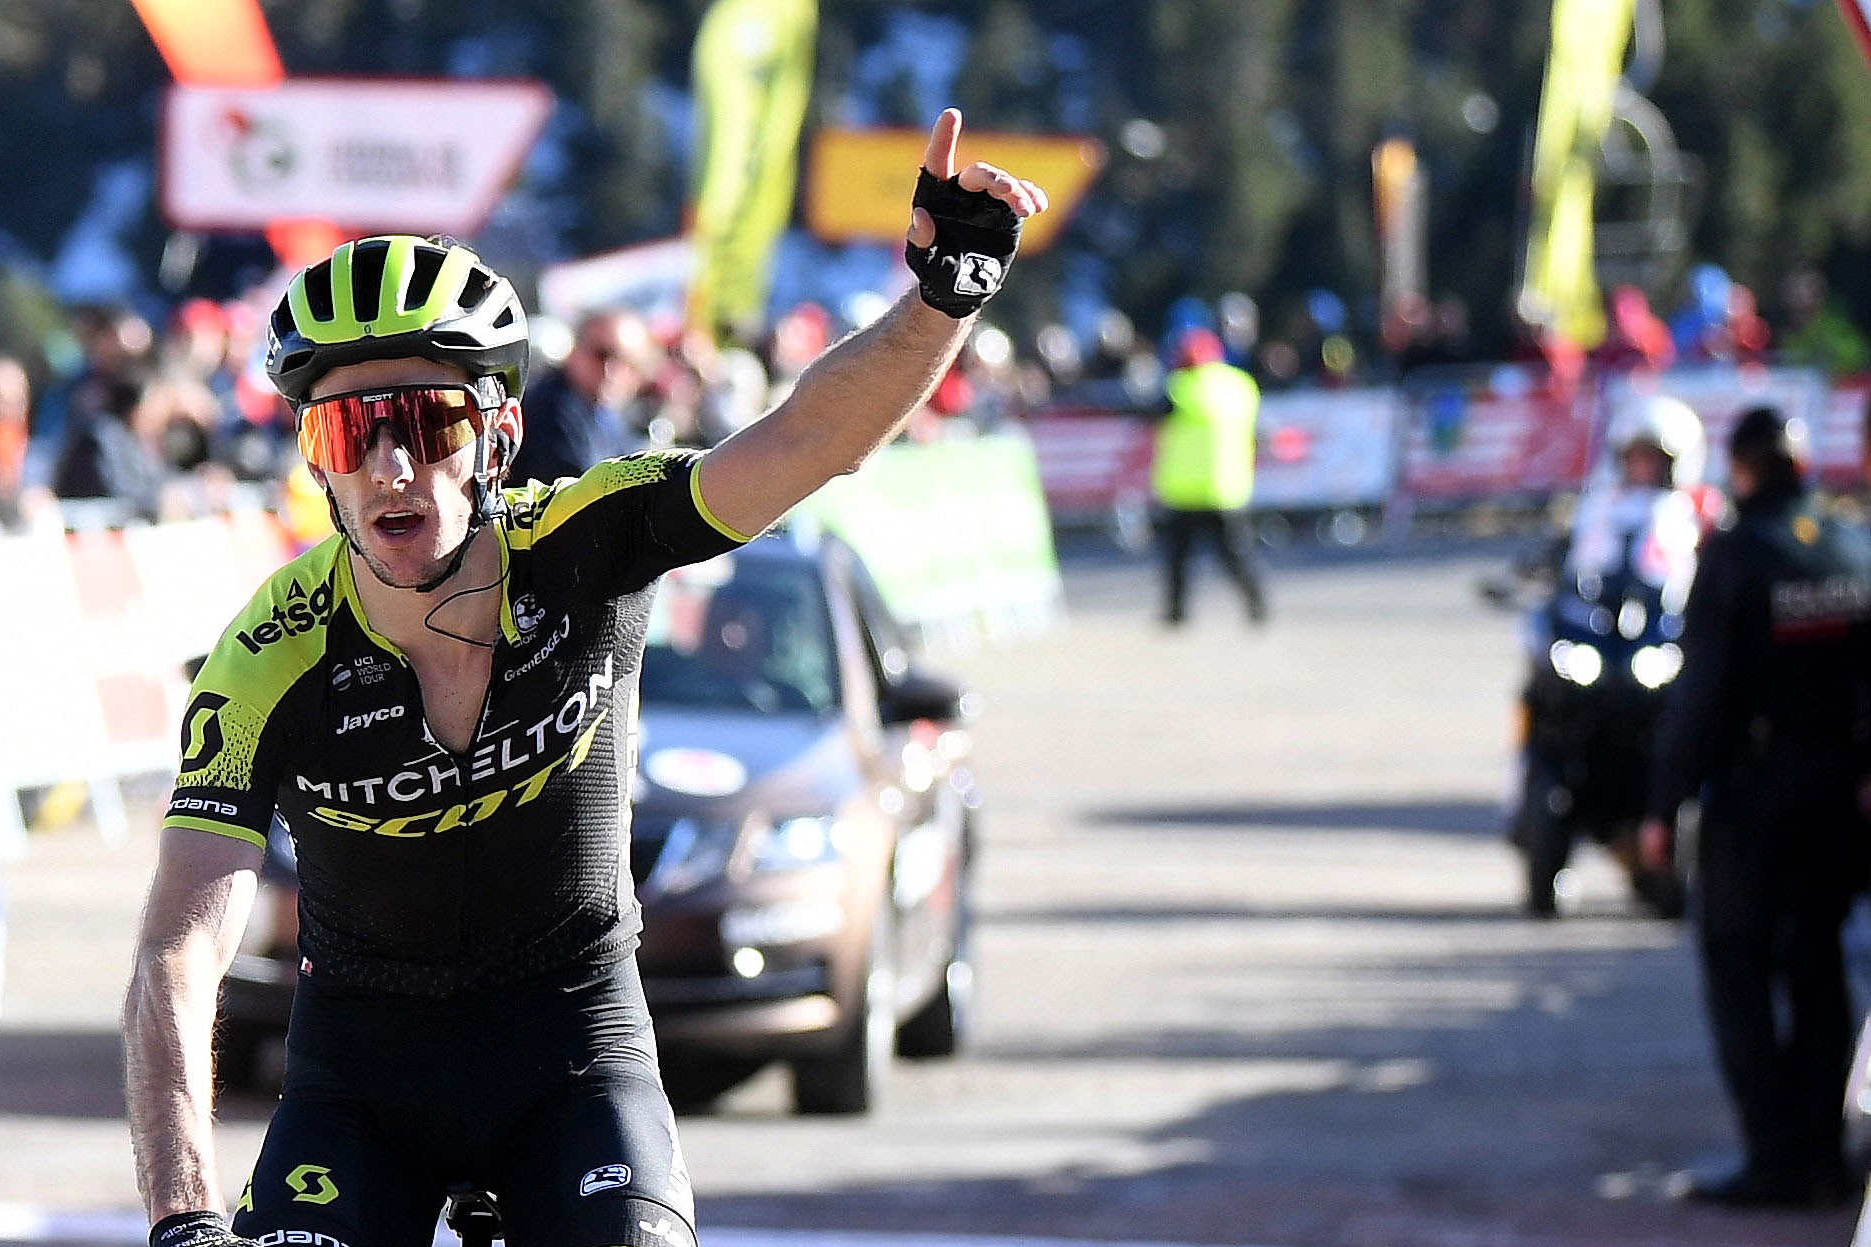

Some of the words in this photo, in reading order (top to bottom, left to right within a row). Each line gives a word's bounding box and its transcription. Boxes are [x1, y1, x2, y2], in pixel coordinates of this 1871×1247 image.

[362, 392, 394, 403] SCOTT
[354, 656, 374, 667] UCI
[504, 629, 561, 682] GreenEDGE
[356, 662, 392, 677] WORLD
[359, 673, 385, 686] TOUR
[296, 653, 614, 805] MITCHELTON
[335, 705, 406, 735] Jayco
[306, 707, 610, 838] SCOTT
